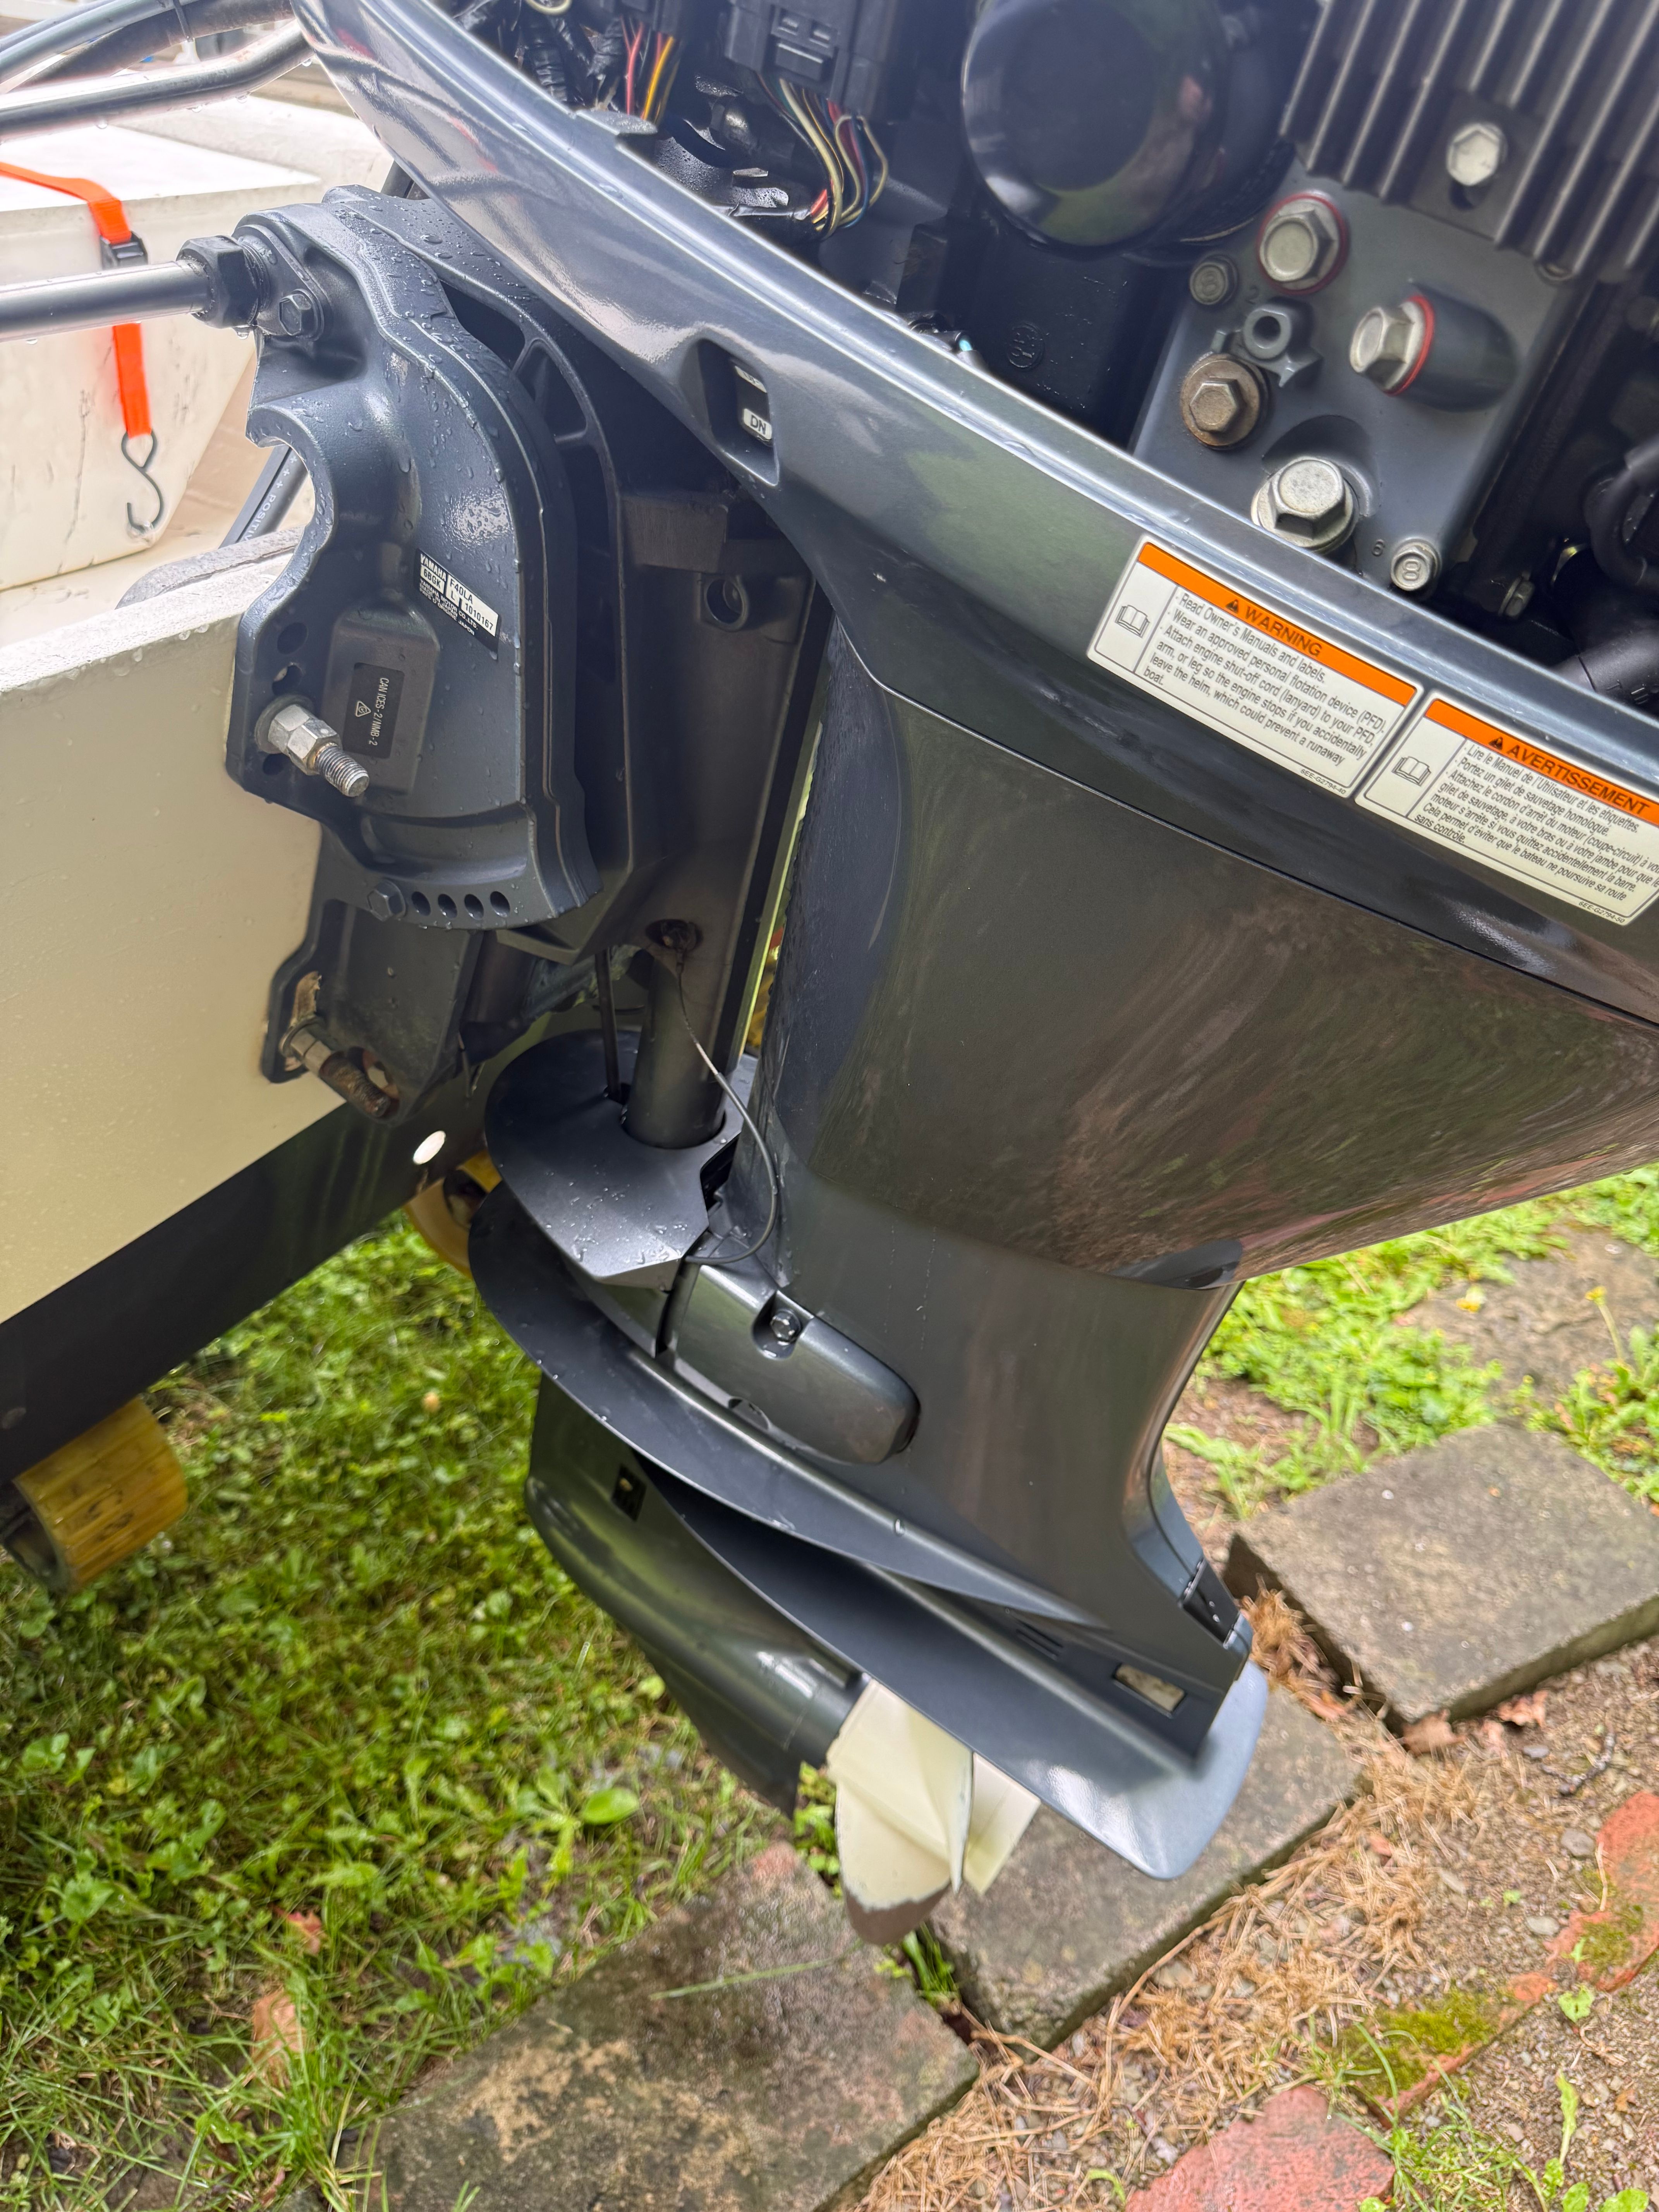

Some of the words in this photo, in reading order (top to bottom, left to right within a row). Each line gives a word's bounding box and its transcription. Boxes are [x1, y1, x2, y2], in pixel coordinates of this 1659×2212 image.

[750, 414, 766, 435] DN
[421, 553, 446, 582] YAMAHA
[1372, 539, 1386, 557] 6
[424, 568, 441, 589] 6BGK
[450, 577, 473, 605] F40LA
[1402, 559, 1421, 581] 8
[420, 579, 439, 598] YAMAHA
[441, 595, 457, 612] MOTOR
[442, 600, 457, 617] JAPAN
[451, 590, 455, 601] L
[465, 601, 493, 632] 1010167
[458, 619, 474, 636] JAPON
[1179, 592, 1205, 616] Read
[1203, 607, 1240, 637] Owner's
[1240, 627, 1279, 657] Manuals
[1278, 651, 1299, 668] and
[1297, 658, 1326, 684] labels.
[1245, 606, 1322, 657] WARNING
[378, 677, 390, 693] CAN
[1143, 665, 1164, 685] boat.
[1164, 625, 1193, 649] Attach
[1193, 643, 1224, 666] engine
[1223, 660, 1261, 685] shut-off
[1259, 680, 1282, 697] cord
[1279, 689, 1322, 720] (lanyard)
[1329, 717, 1355, 734] your
[1353, 726, 1375, 747] PFD,
[1173, 608, 1196, 630] Wear
[1207, 632, 1252, 661] approved
[1247, 655, 1291, 683] personal
[1289, 674, 1328, 703] flotation
[1328, 696, 1358, 718] device
[1356, 710, 1386, 734] (PFD).
[368, 692, 387, 746] ICES-2/NMB-2
[1150, 652, 1173, 673] leave
[1173, 666, 1188, 682] the
[1188, 674, 1211, 696] helm,
[1213, 690, 1240, 710] which
[1240, 705, 1267, 724] could
[1263, 718, 1300, 742] prevent
[1306, 740, 1345, 766] runaway
[1156, 641, 1175, 658] arm,
[1188, 656, 1203, 675] leg
[1215, 672, 1231, 687] the
[1230, 682, 1261, 704] engine
[1261, 699, 1287, 718] stops
[1292, 716, 1314, 732] you
[1312, 726, 1367, 761] accidentally
[1457, 757, 1485, 778] Portez
[1492, 777, 1515, 792] gilet
[1523, 792, 1565, 816] sauvetage
[1563, 808, 1611, 836] homologué.
[1467, 744, 1485, 761] Lire
[1491, 757, 1524, 779] Manuel
[1531, 776, 1579, 805] l'Utilisateur
[1585, 801, 1601, 815] les
[1599, 807, 1639, 833] étiquettes.
[1506, 745, 1650, 814] AVERTISSEMENT
[1414, 814, 1434, 828] sans
[1433, 823, 1465, 843] contrôle.
[1437, 782, 1460, 796] gilet
[1468, 796, 1508, 823] sauvetage,
[1516, 819, 1538, 834] votre
[1536, 827, 1556, 842] bras
[1573, 845, 1595, 859] votre
[1590, 852, 1619, 870] jambe
[1614, 865, 1638, 878] pour
[1635, 873, 1653, 884] que
[1448, 769, 1484, 793] Attachez
[1491, 792, 1520, 811] cordon
[1519, 804, 1548, 823] d'arrêt
[1556, 823, 1587, 840] moteur
[1583, 832, 1643, 866] (coupe-circuit)
[1423, 802, 1441, 818] Cela
[1438, 812, 1470, 833] permet
[1467, 824, 1498, 843] d'éviter
[1496, 839, 1513, 850] que
[1519, 848, 1547, 867] bateau
[1554, 867, 1596, 888] poursuive
[1604, 888, 1627, 901] route
[1430, 793, 1460, 811] moteur
[1496, 824, 1517, 839] vous
[1516, 834, 1544, 852] quittez
[1542, 847, 1608, 879] accidentellement
[1613, 876, 1636, 892] barre.
